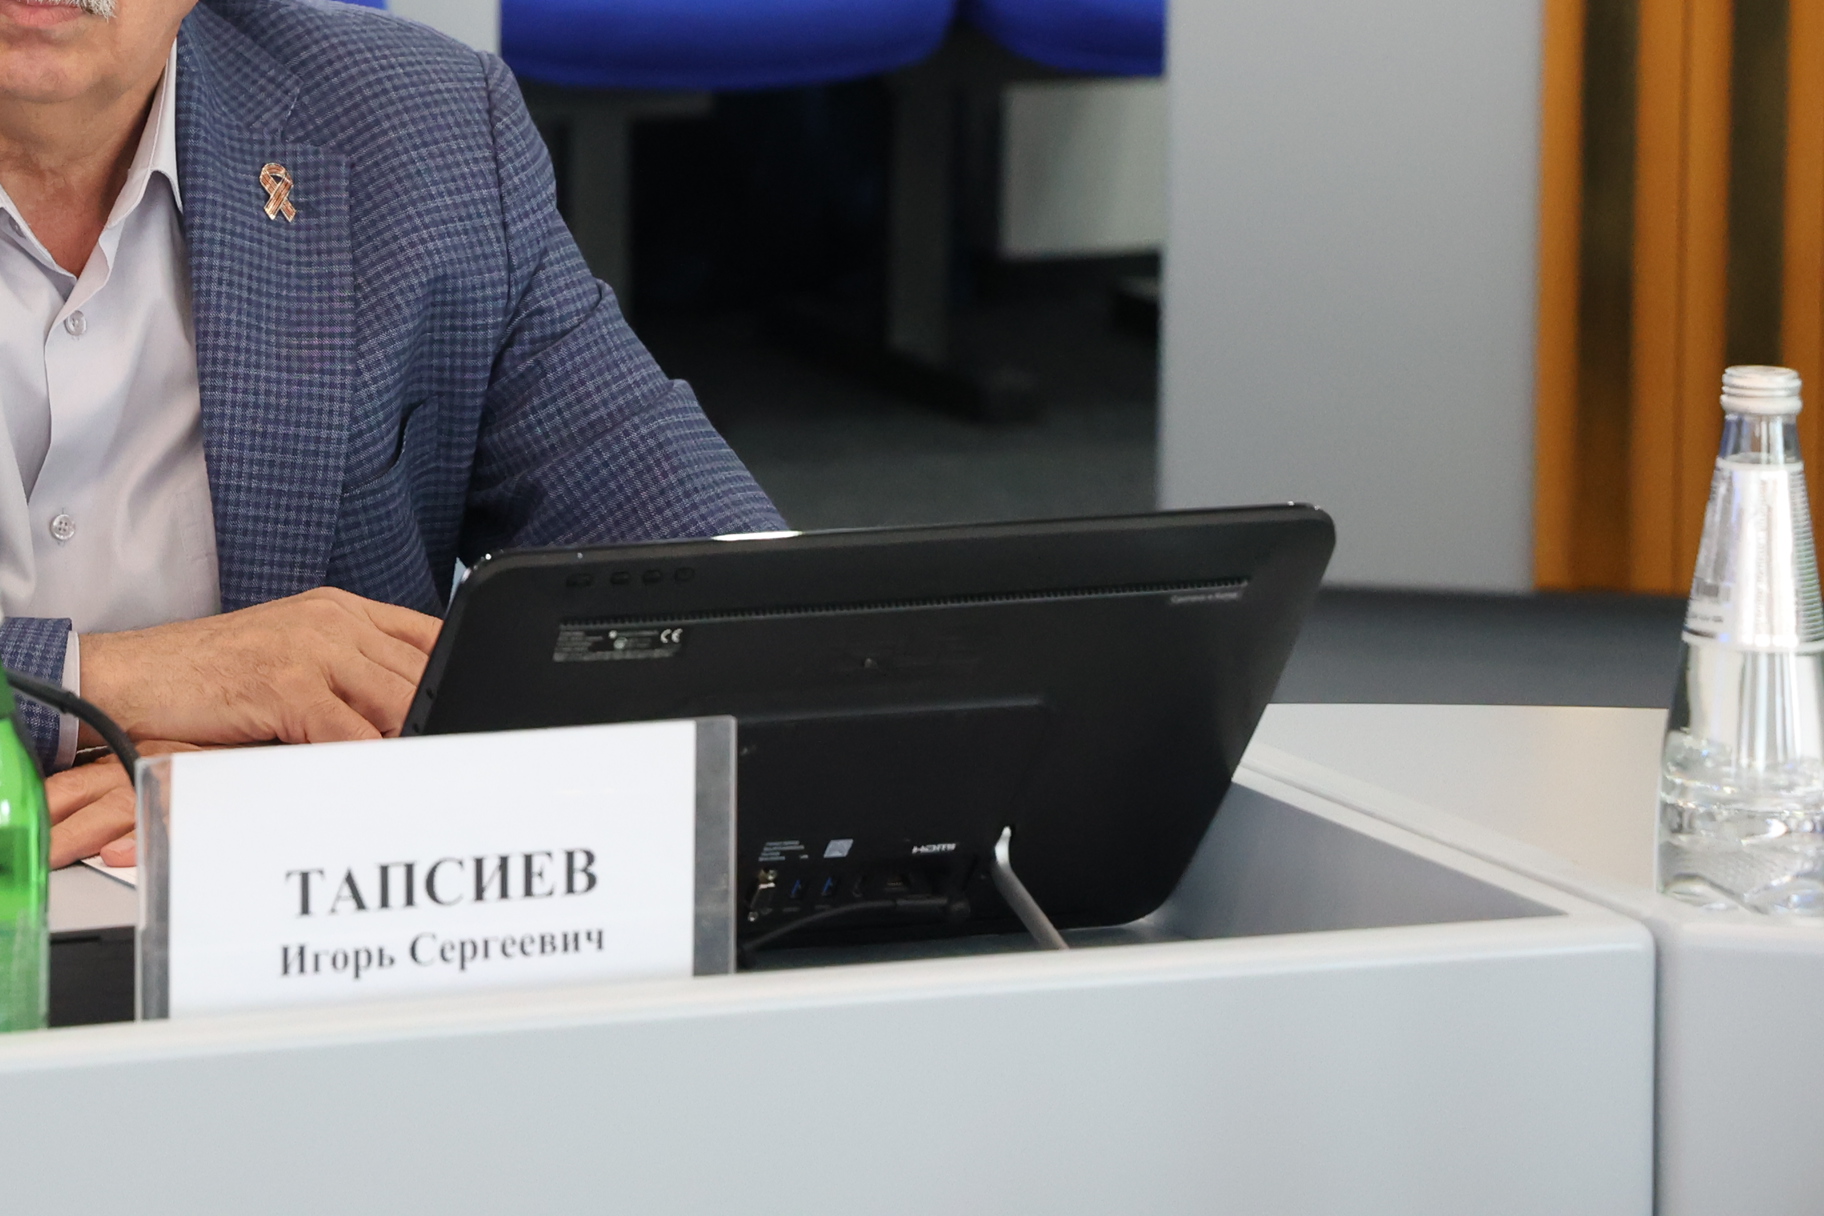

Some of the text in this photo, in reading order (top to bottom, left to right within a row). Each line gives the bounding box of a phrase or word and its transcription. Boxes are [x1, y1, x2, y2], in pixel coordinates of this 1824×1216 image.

[285, 847, 598, 917] ТАПСИЕВ
[280, 928, 605, 980] Игорь Сергеевич
